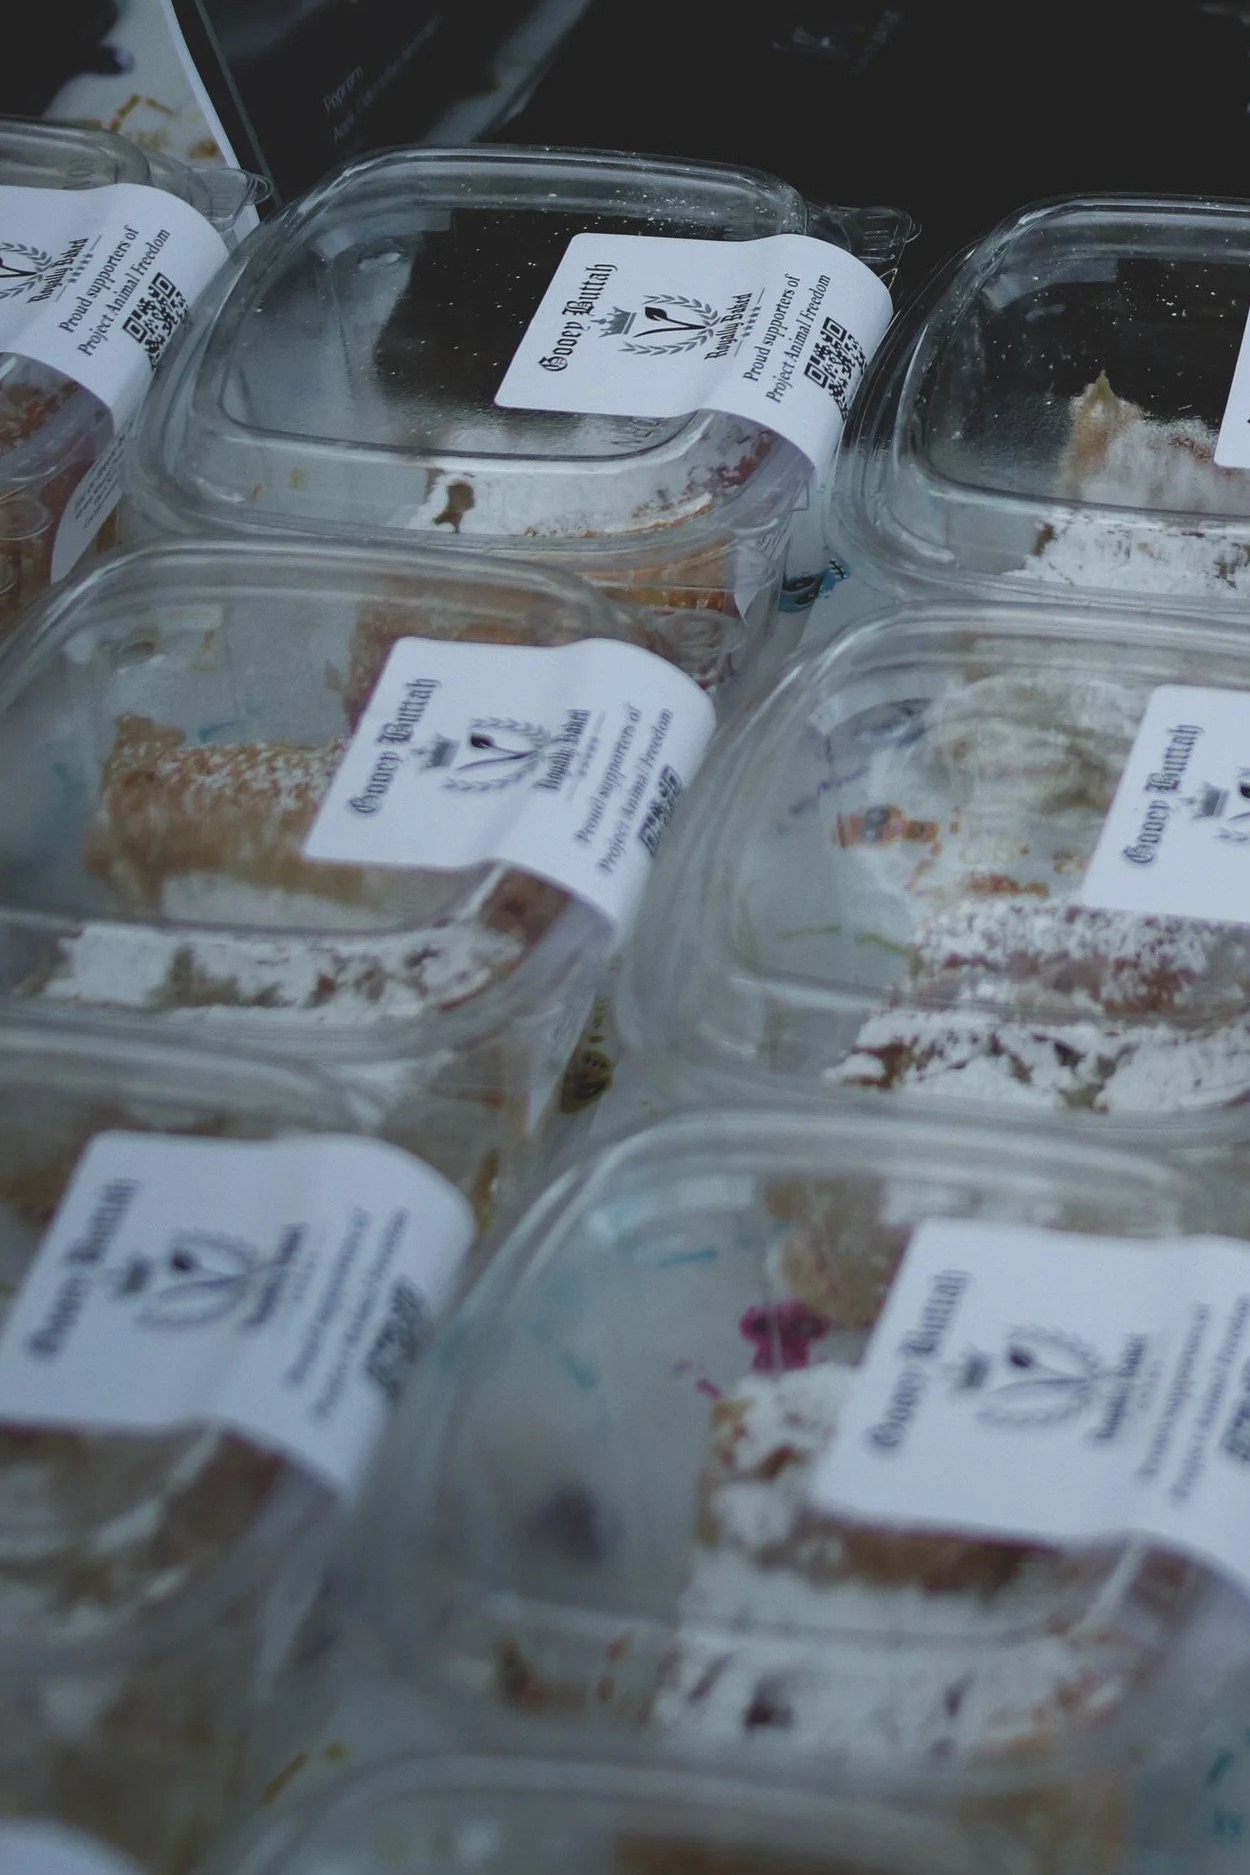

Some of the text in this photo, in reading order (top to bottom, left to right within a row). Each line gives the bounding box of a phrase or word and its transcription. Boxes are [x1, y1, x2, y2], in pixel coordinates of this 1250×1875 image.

[322, 65, 365, 114] Popcorn
[27, 238, 89, 303] Royally Baked
[58, 224, 140, 333] Proud supporters of
[77, 228, 171, 356] Project Animal Freedom
[538, 262, 618, 373] Gooey Buttah
[704, 291, 753, 360] Royally Baked
[743, 273, 801, 382] Proud supporters of
[766, 274, 832, 404] Project Animal Freedom
[347, 677, 441, 815] Gooey Buttah
[1122, 724, 1205, 865] Gooey Buttah
